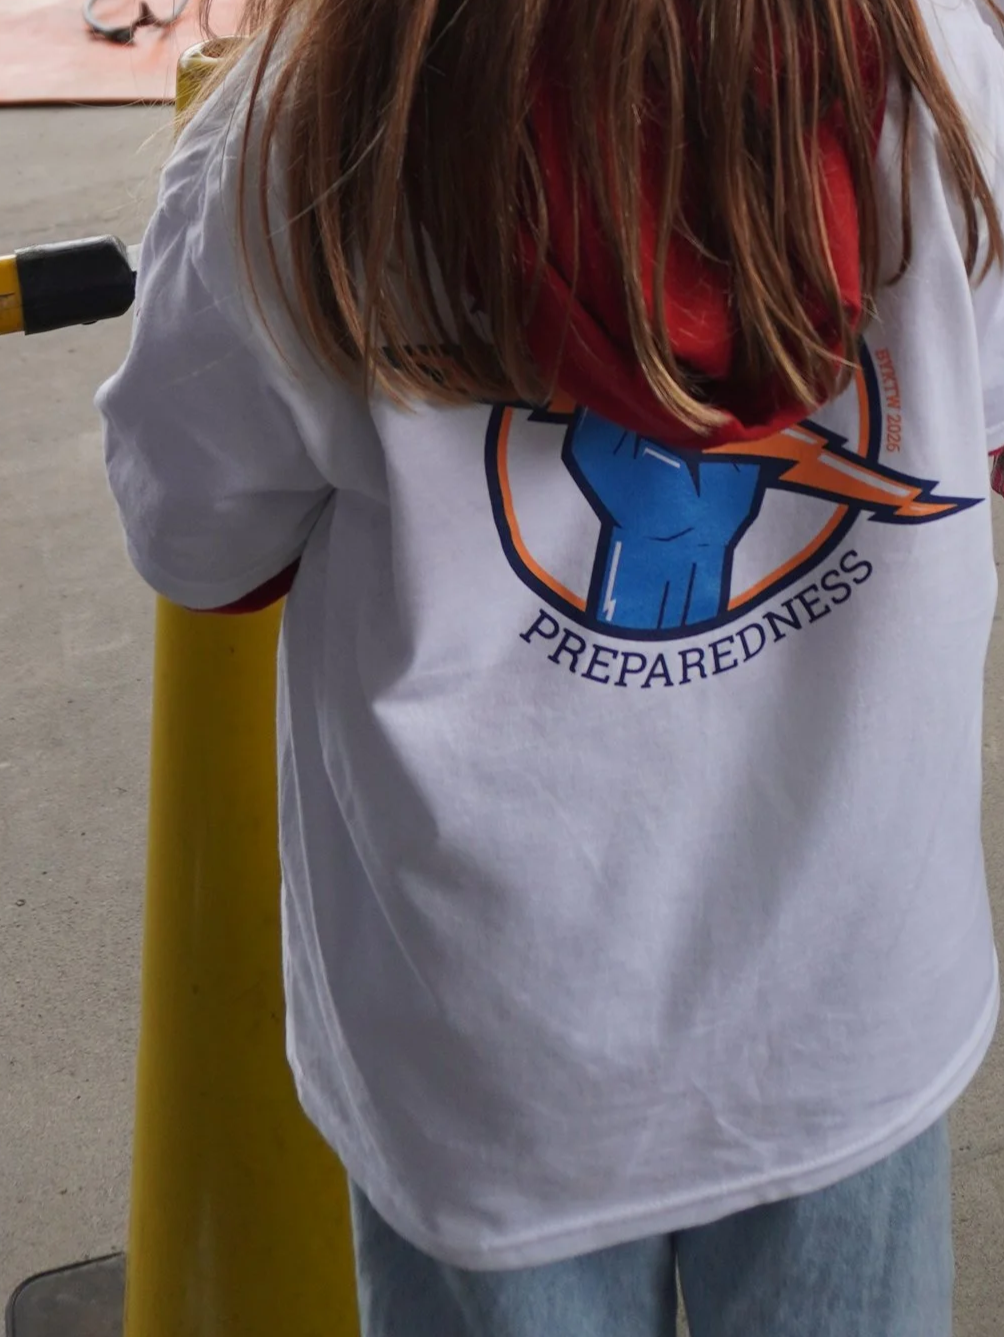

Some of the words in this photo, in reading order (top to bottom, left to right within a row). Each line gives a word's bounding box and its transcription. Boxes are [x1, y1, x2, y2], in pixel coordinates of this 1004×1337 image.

[875, 347, 900, 409] BYKTW
[886, 414, 903, 453] 2026
[519, 550, 874, 689] PREPAREDNESS
